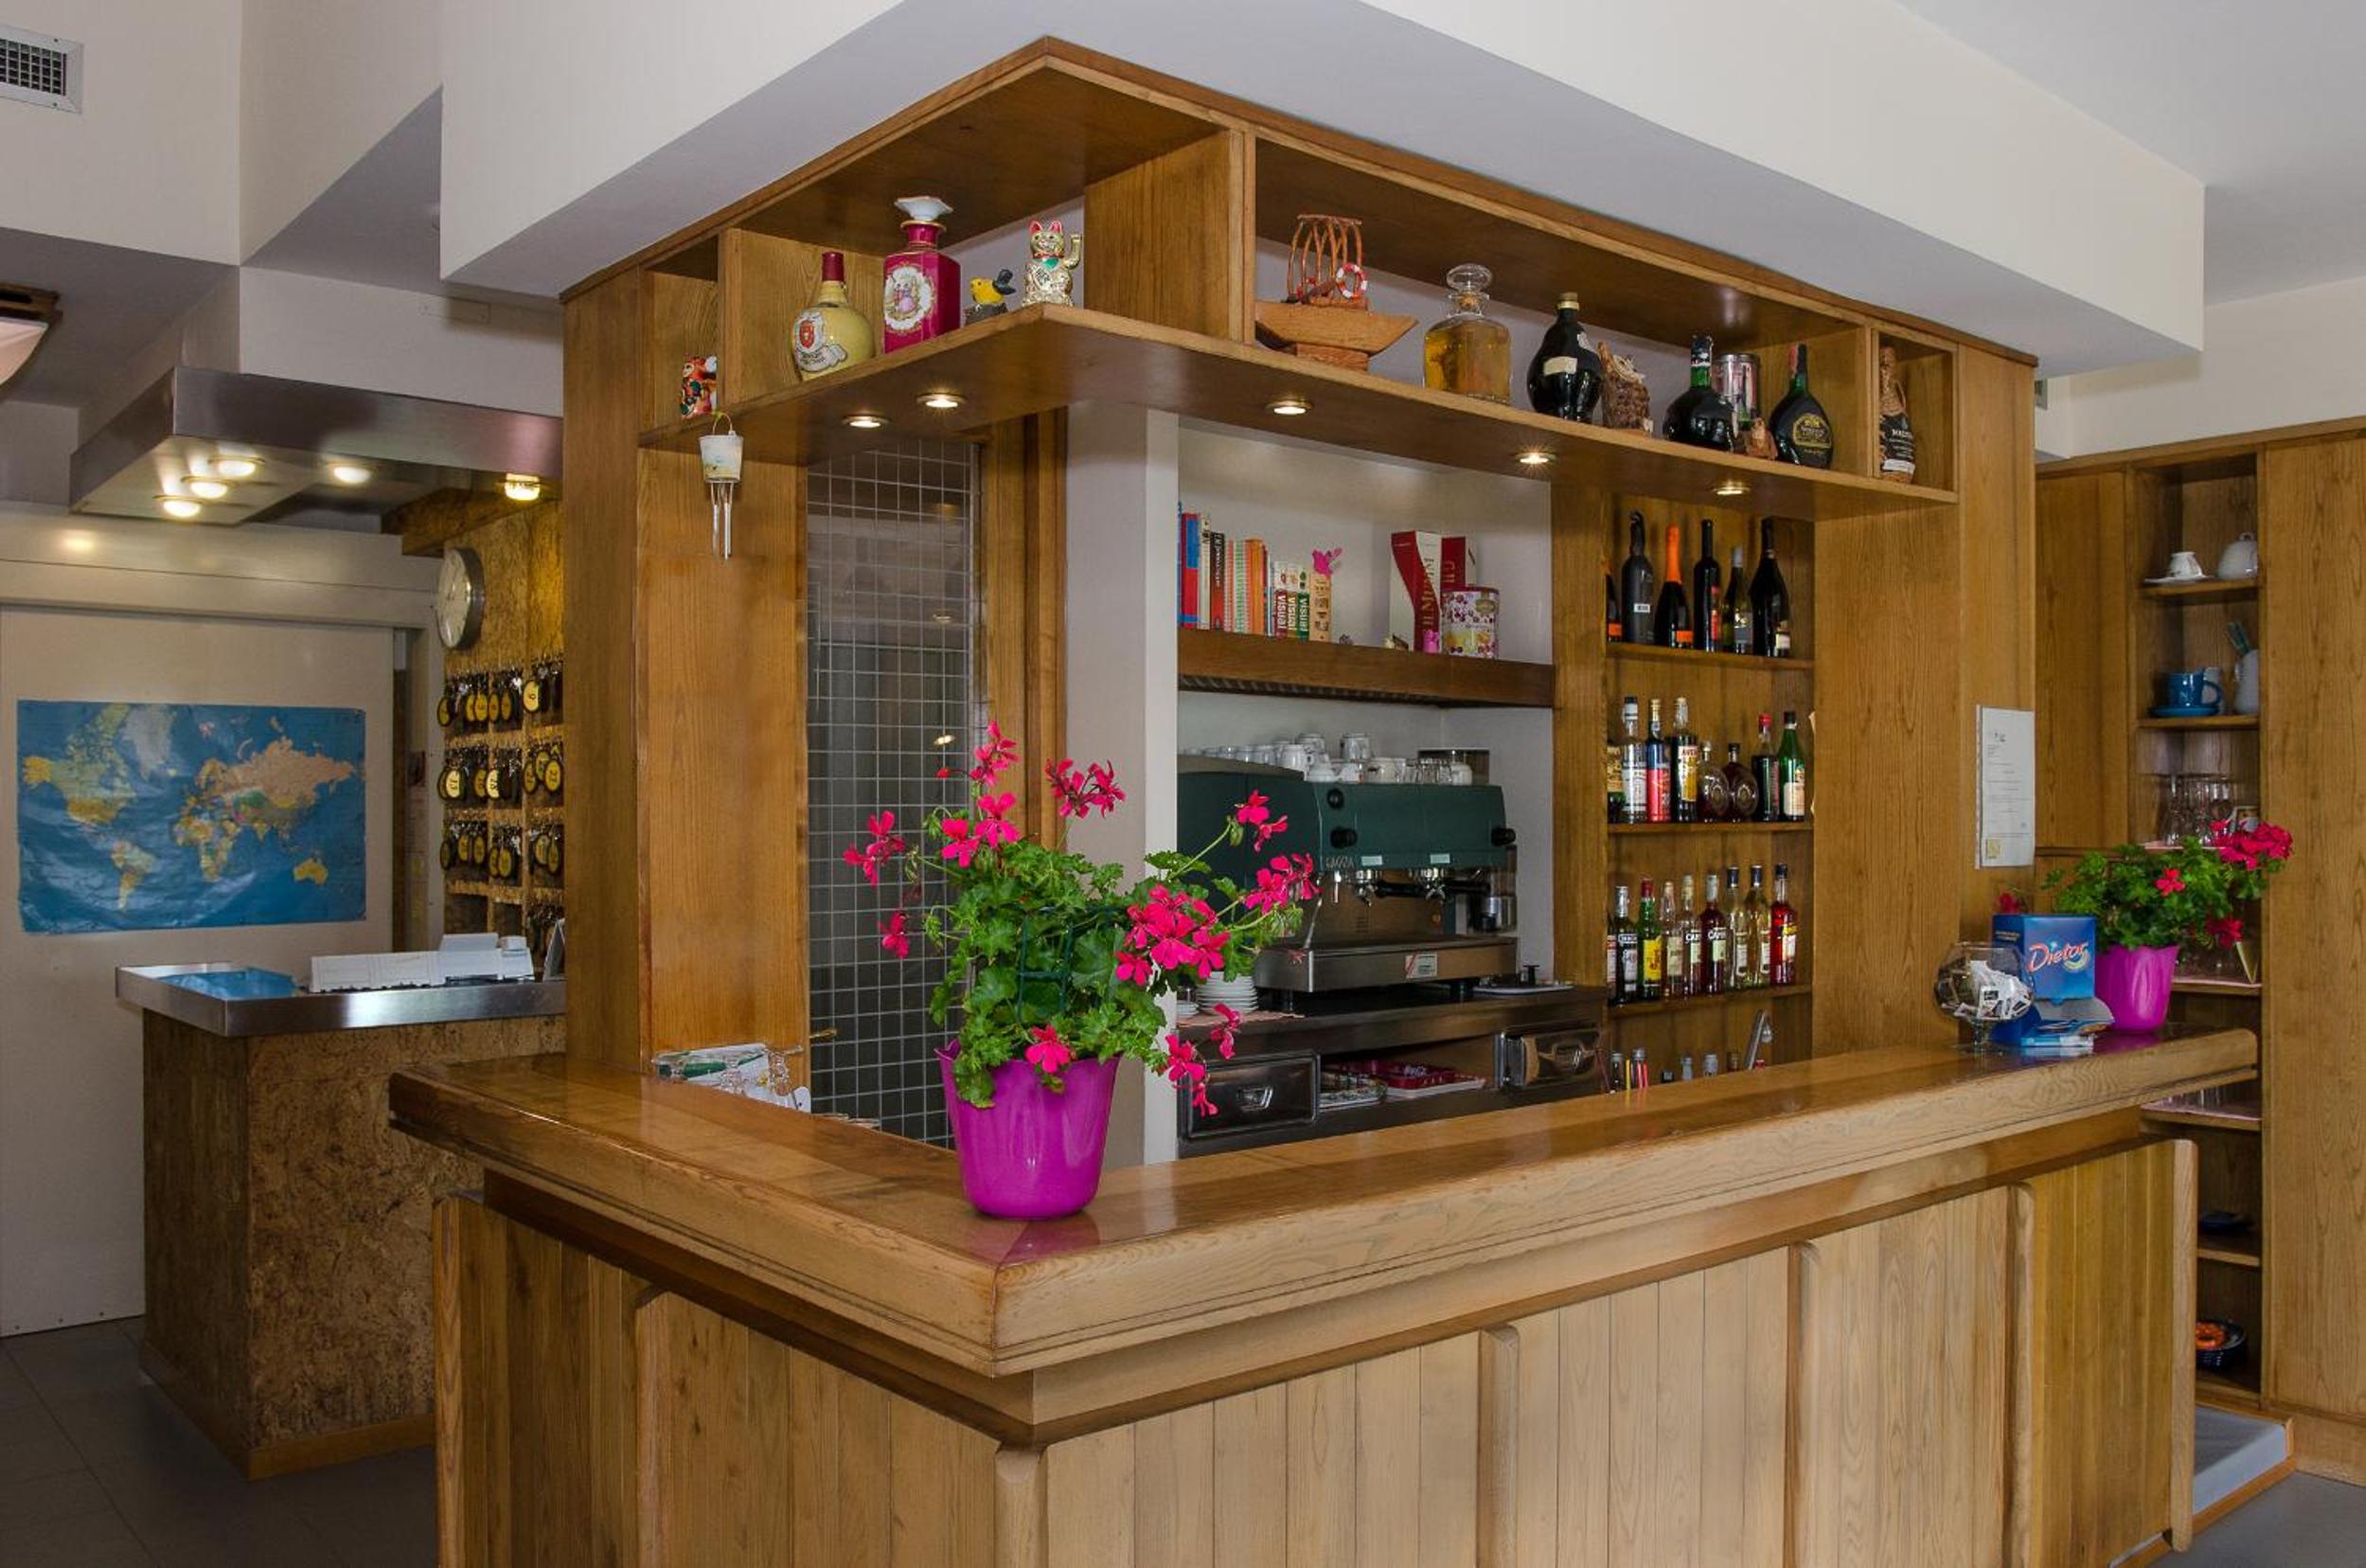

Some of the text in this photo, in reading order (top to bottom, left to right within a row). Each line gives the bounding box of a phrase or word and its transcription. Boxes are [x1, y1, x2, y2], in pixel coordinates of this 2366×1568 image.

[1277, 595, 1288, 630] visual
[1288, 597, 1297, 631] visual
[1299, 597, 1308, 632] visual
[2025, 940, 2089, 973] Dietor
